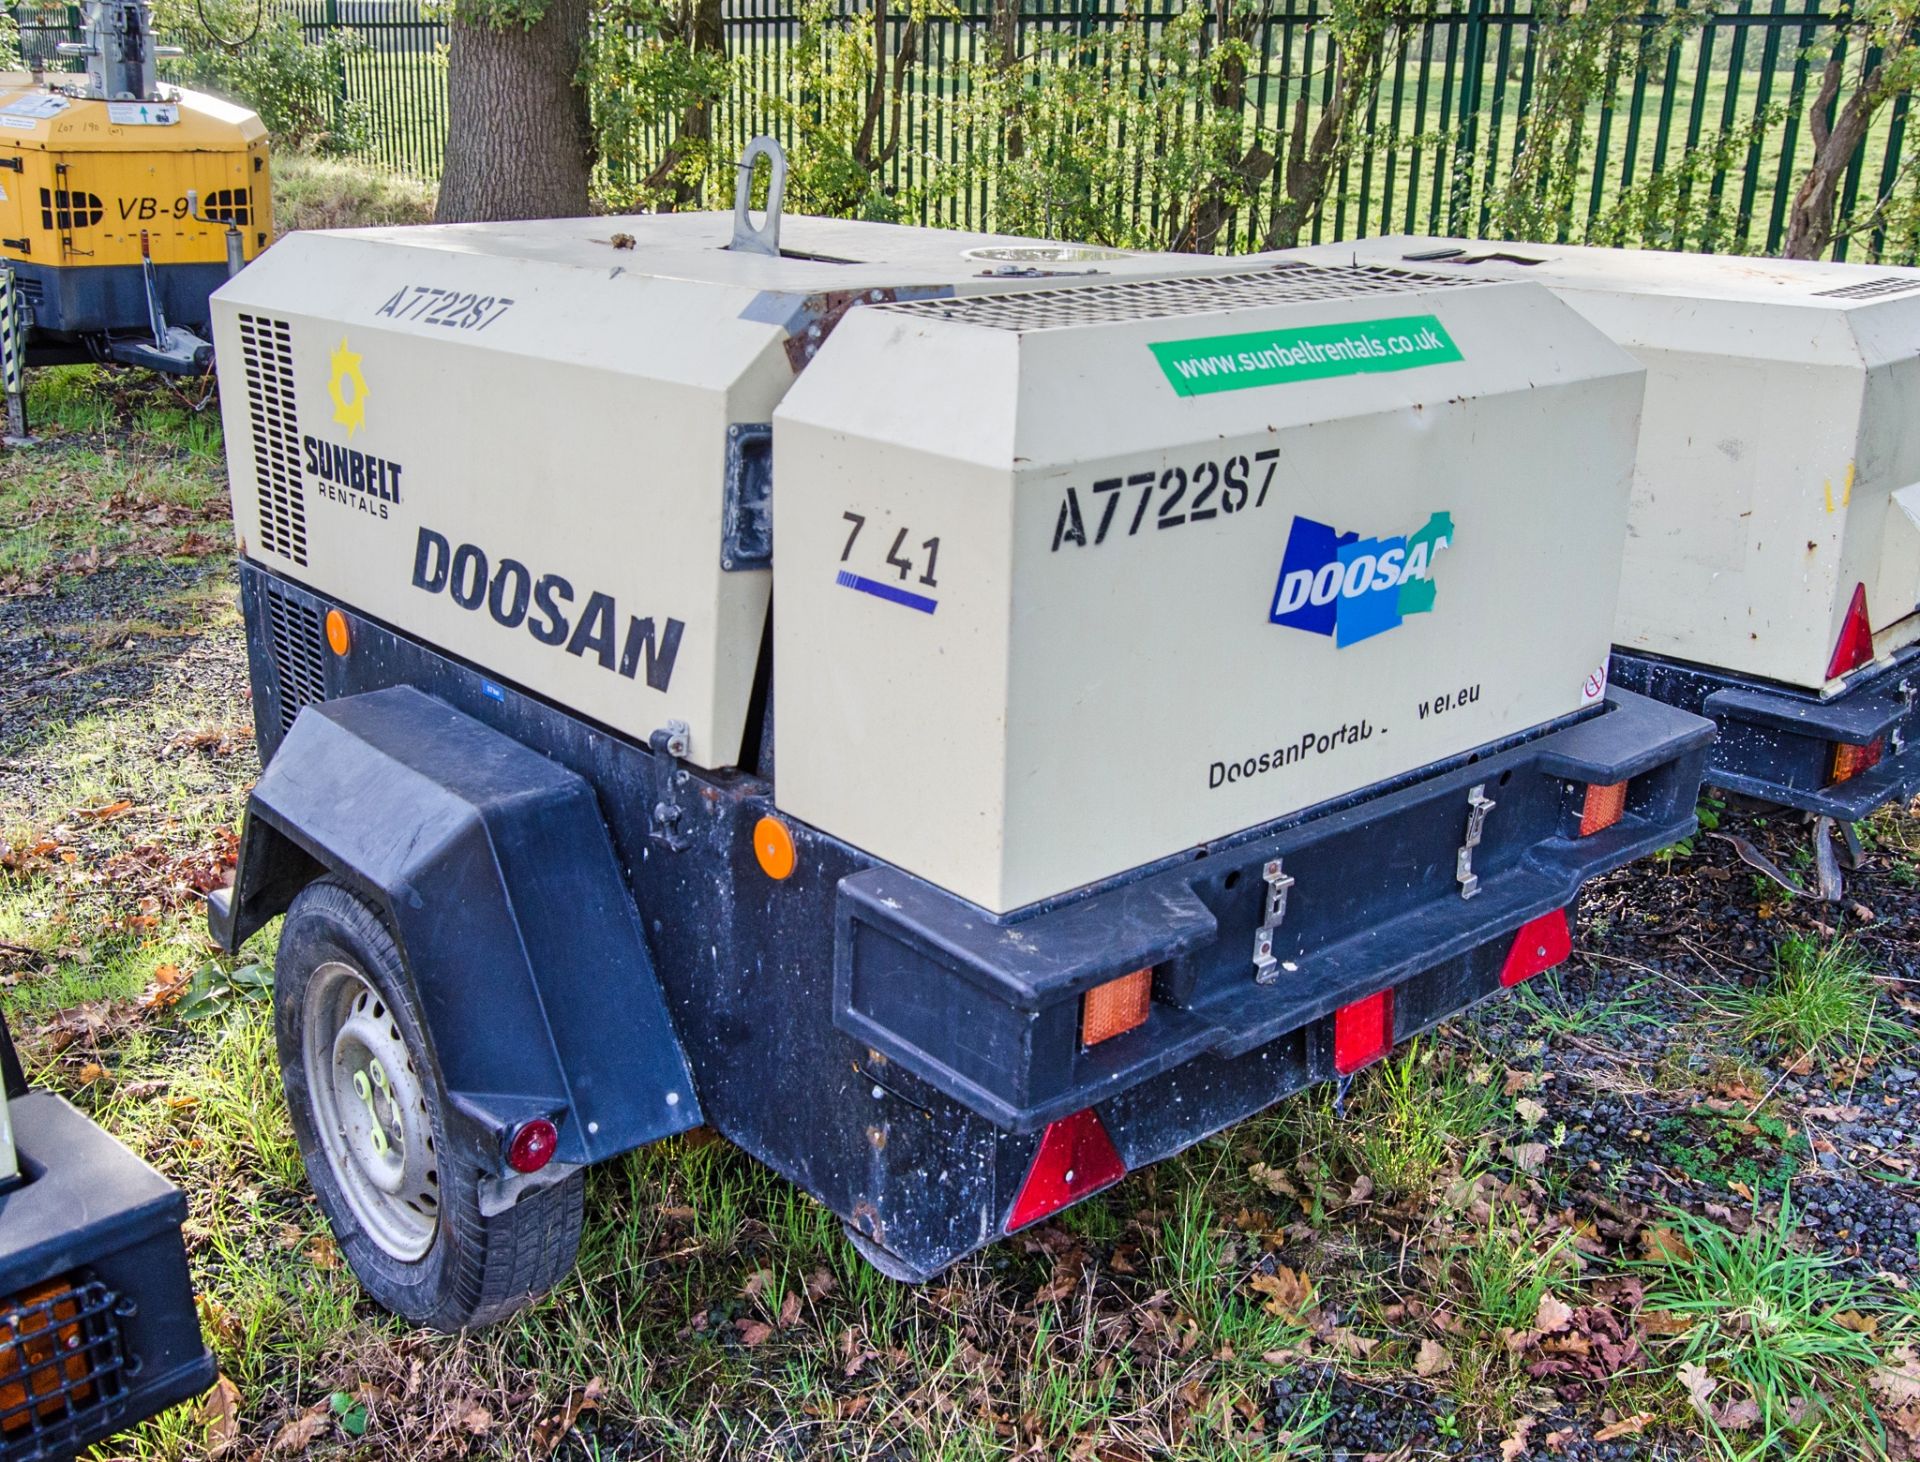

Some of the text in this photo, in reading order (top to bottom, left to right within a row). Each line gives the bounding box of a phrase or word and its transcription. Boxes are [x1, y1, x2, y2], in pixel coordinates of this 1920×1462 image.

[118, 197, 189, 220] VB-9
[1173, 327, 1444, 379] www.sunbeltrentals.co.uk
[303, 435, 402, 505] SUNBELT
[318, 481, 388, 520] RENTALS
[412, 526, 686, 693] DOOSAN
